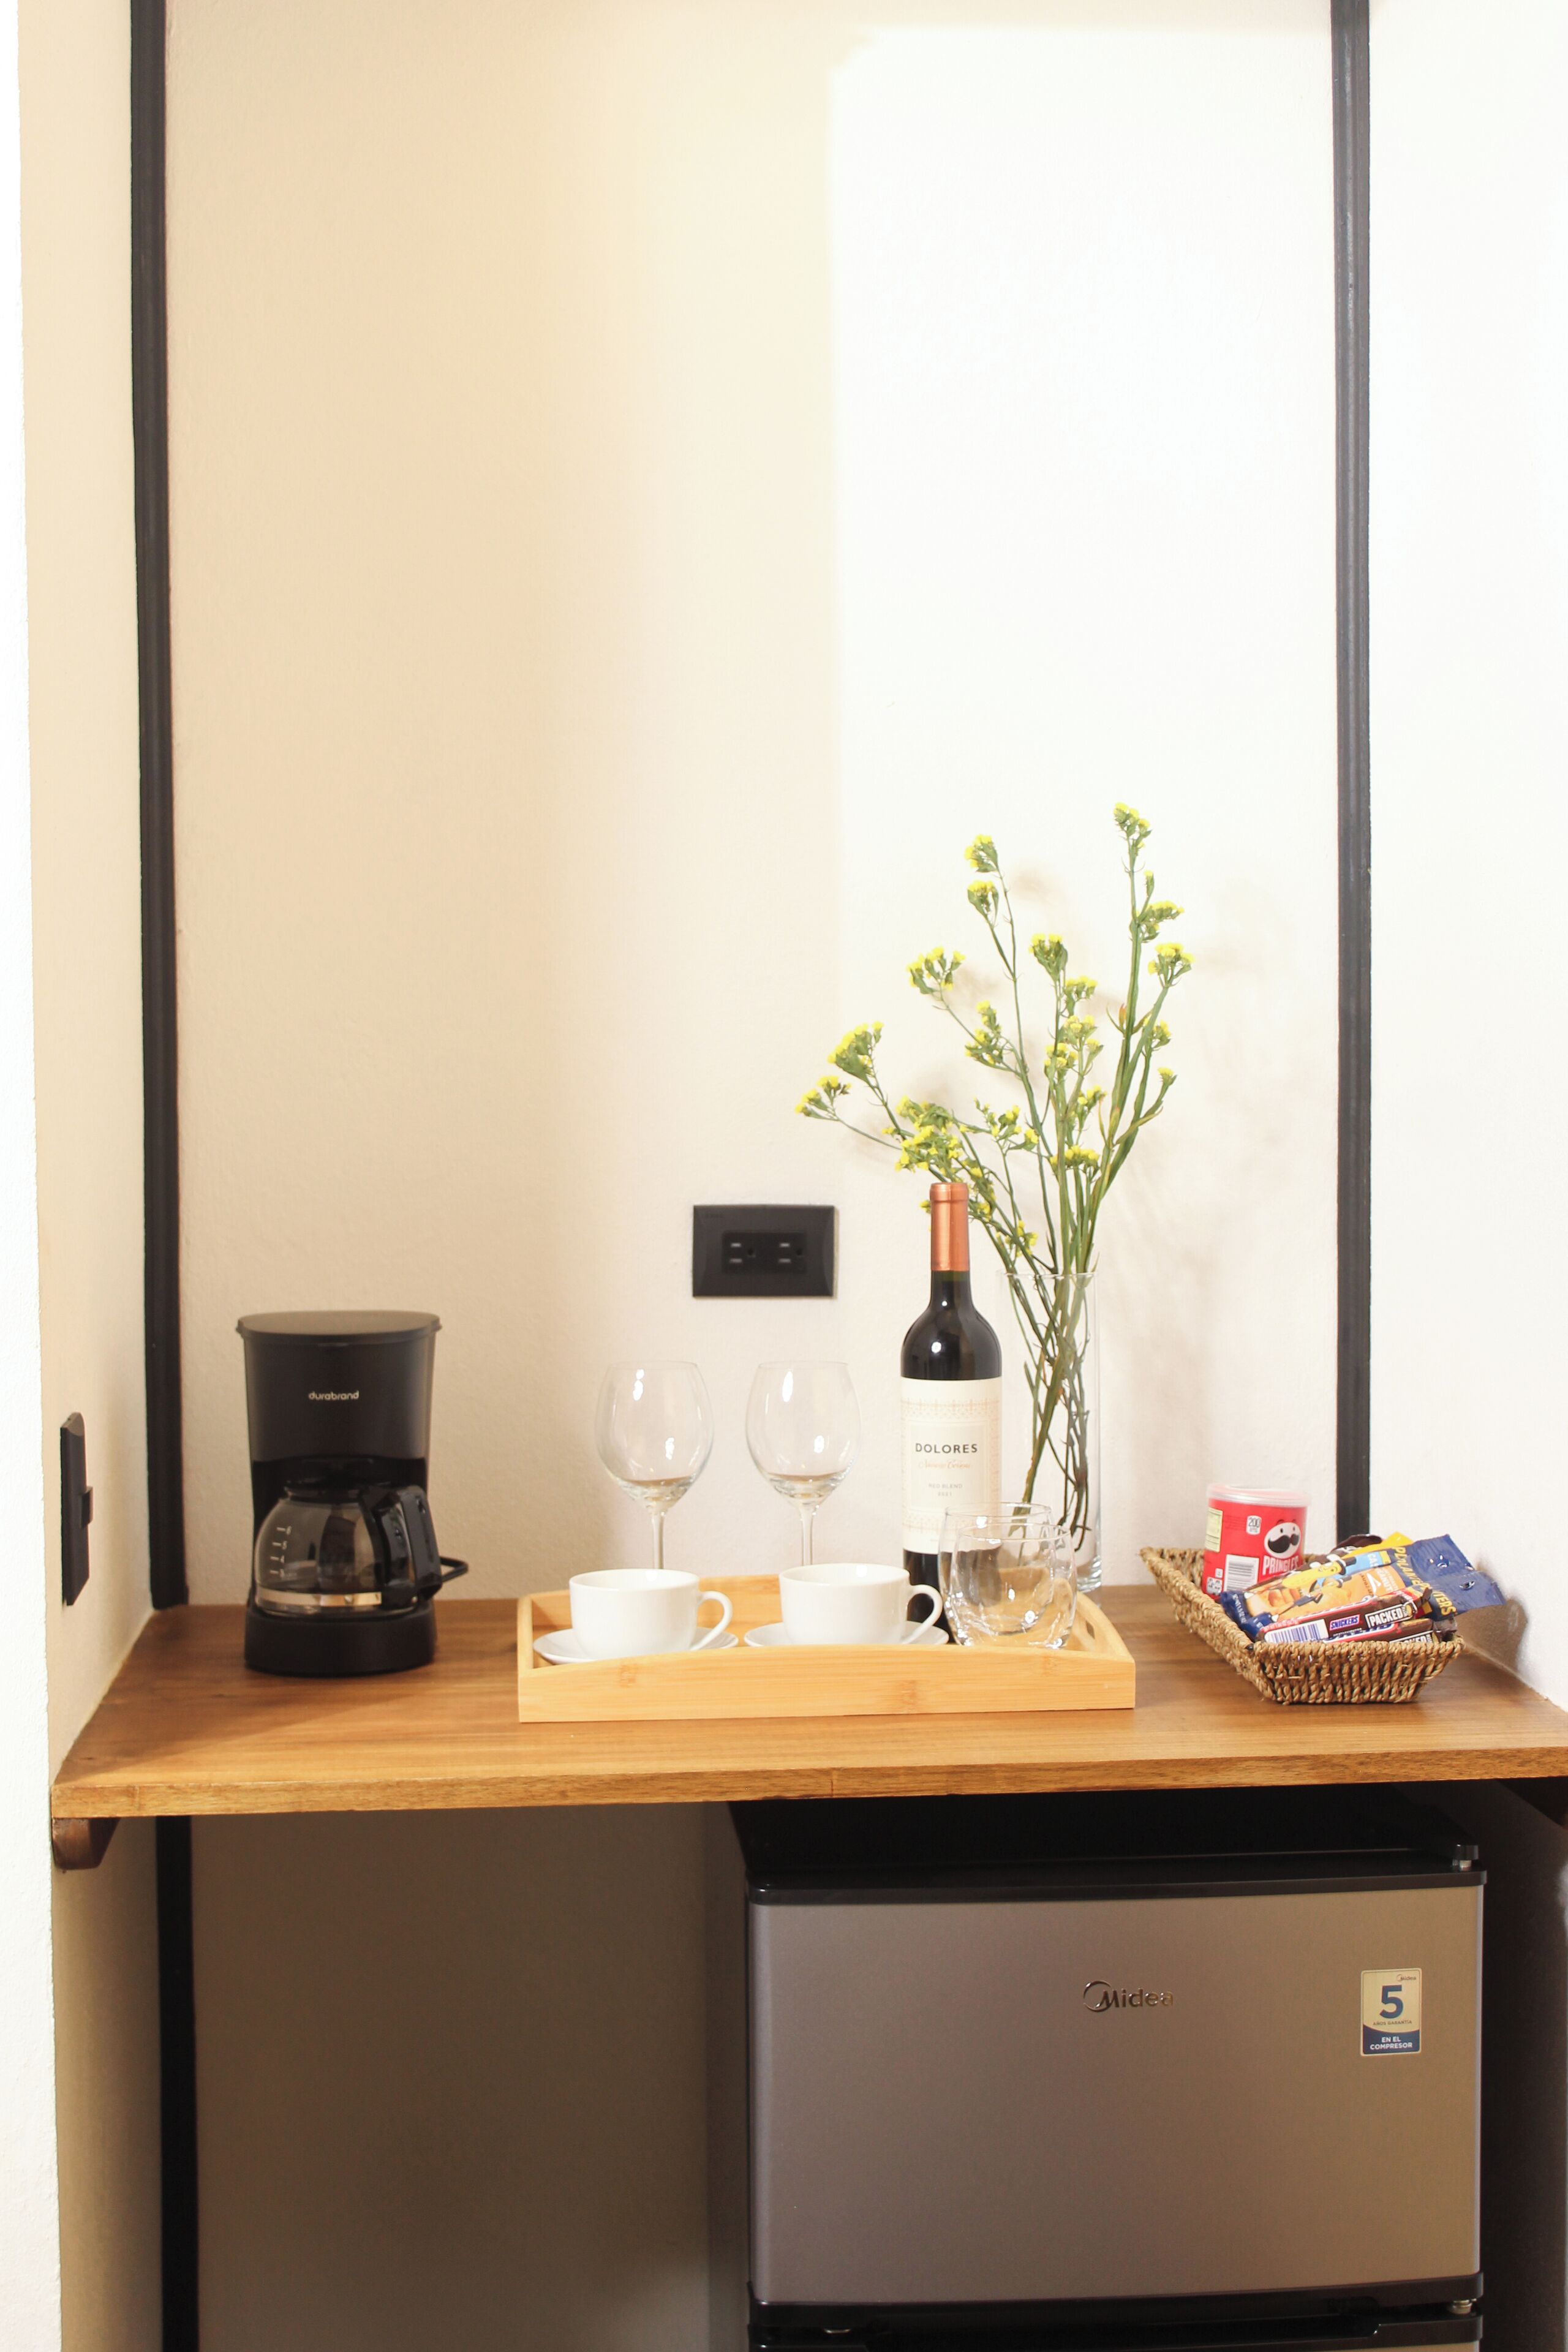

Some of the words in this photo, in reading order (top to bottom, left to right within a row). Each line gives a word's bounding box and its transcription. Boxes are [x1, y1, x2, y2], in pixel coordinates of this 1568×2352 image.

[309, 1390, 360, 1401] durabrand
[915, 1443, 978, 1453] DOLORES
[1262, 1555, 1299, 1576] PRINGLES
[1331, 1616, 1358, 1629] SNICKERS
[1369, 1607, 1403, 1627] PACKED
[1083, 1980, 1174, 2013] Midea
[1379, 1985, 1403, 2019] 5
